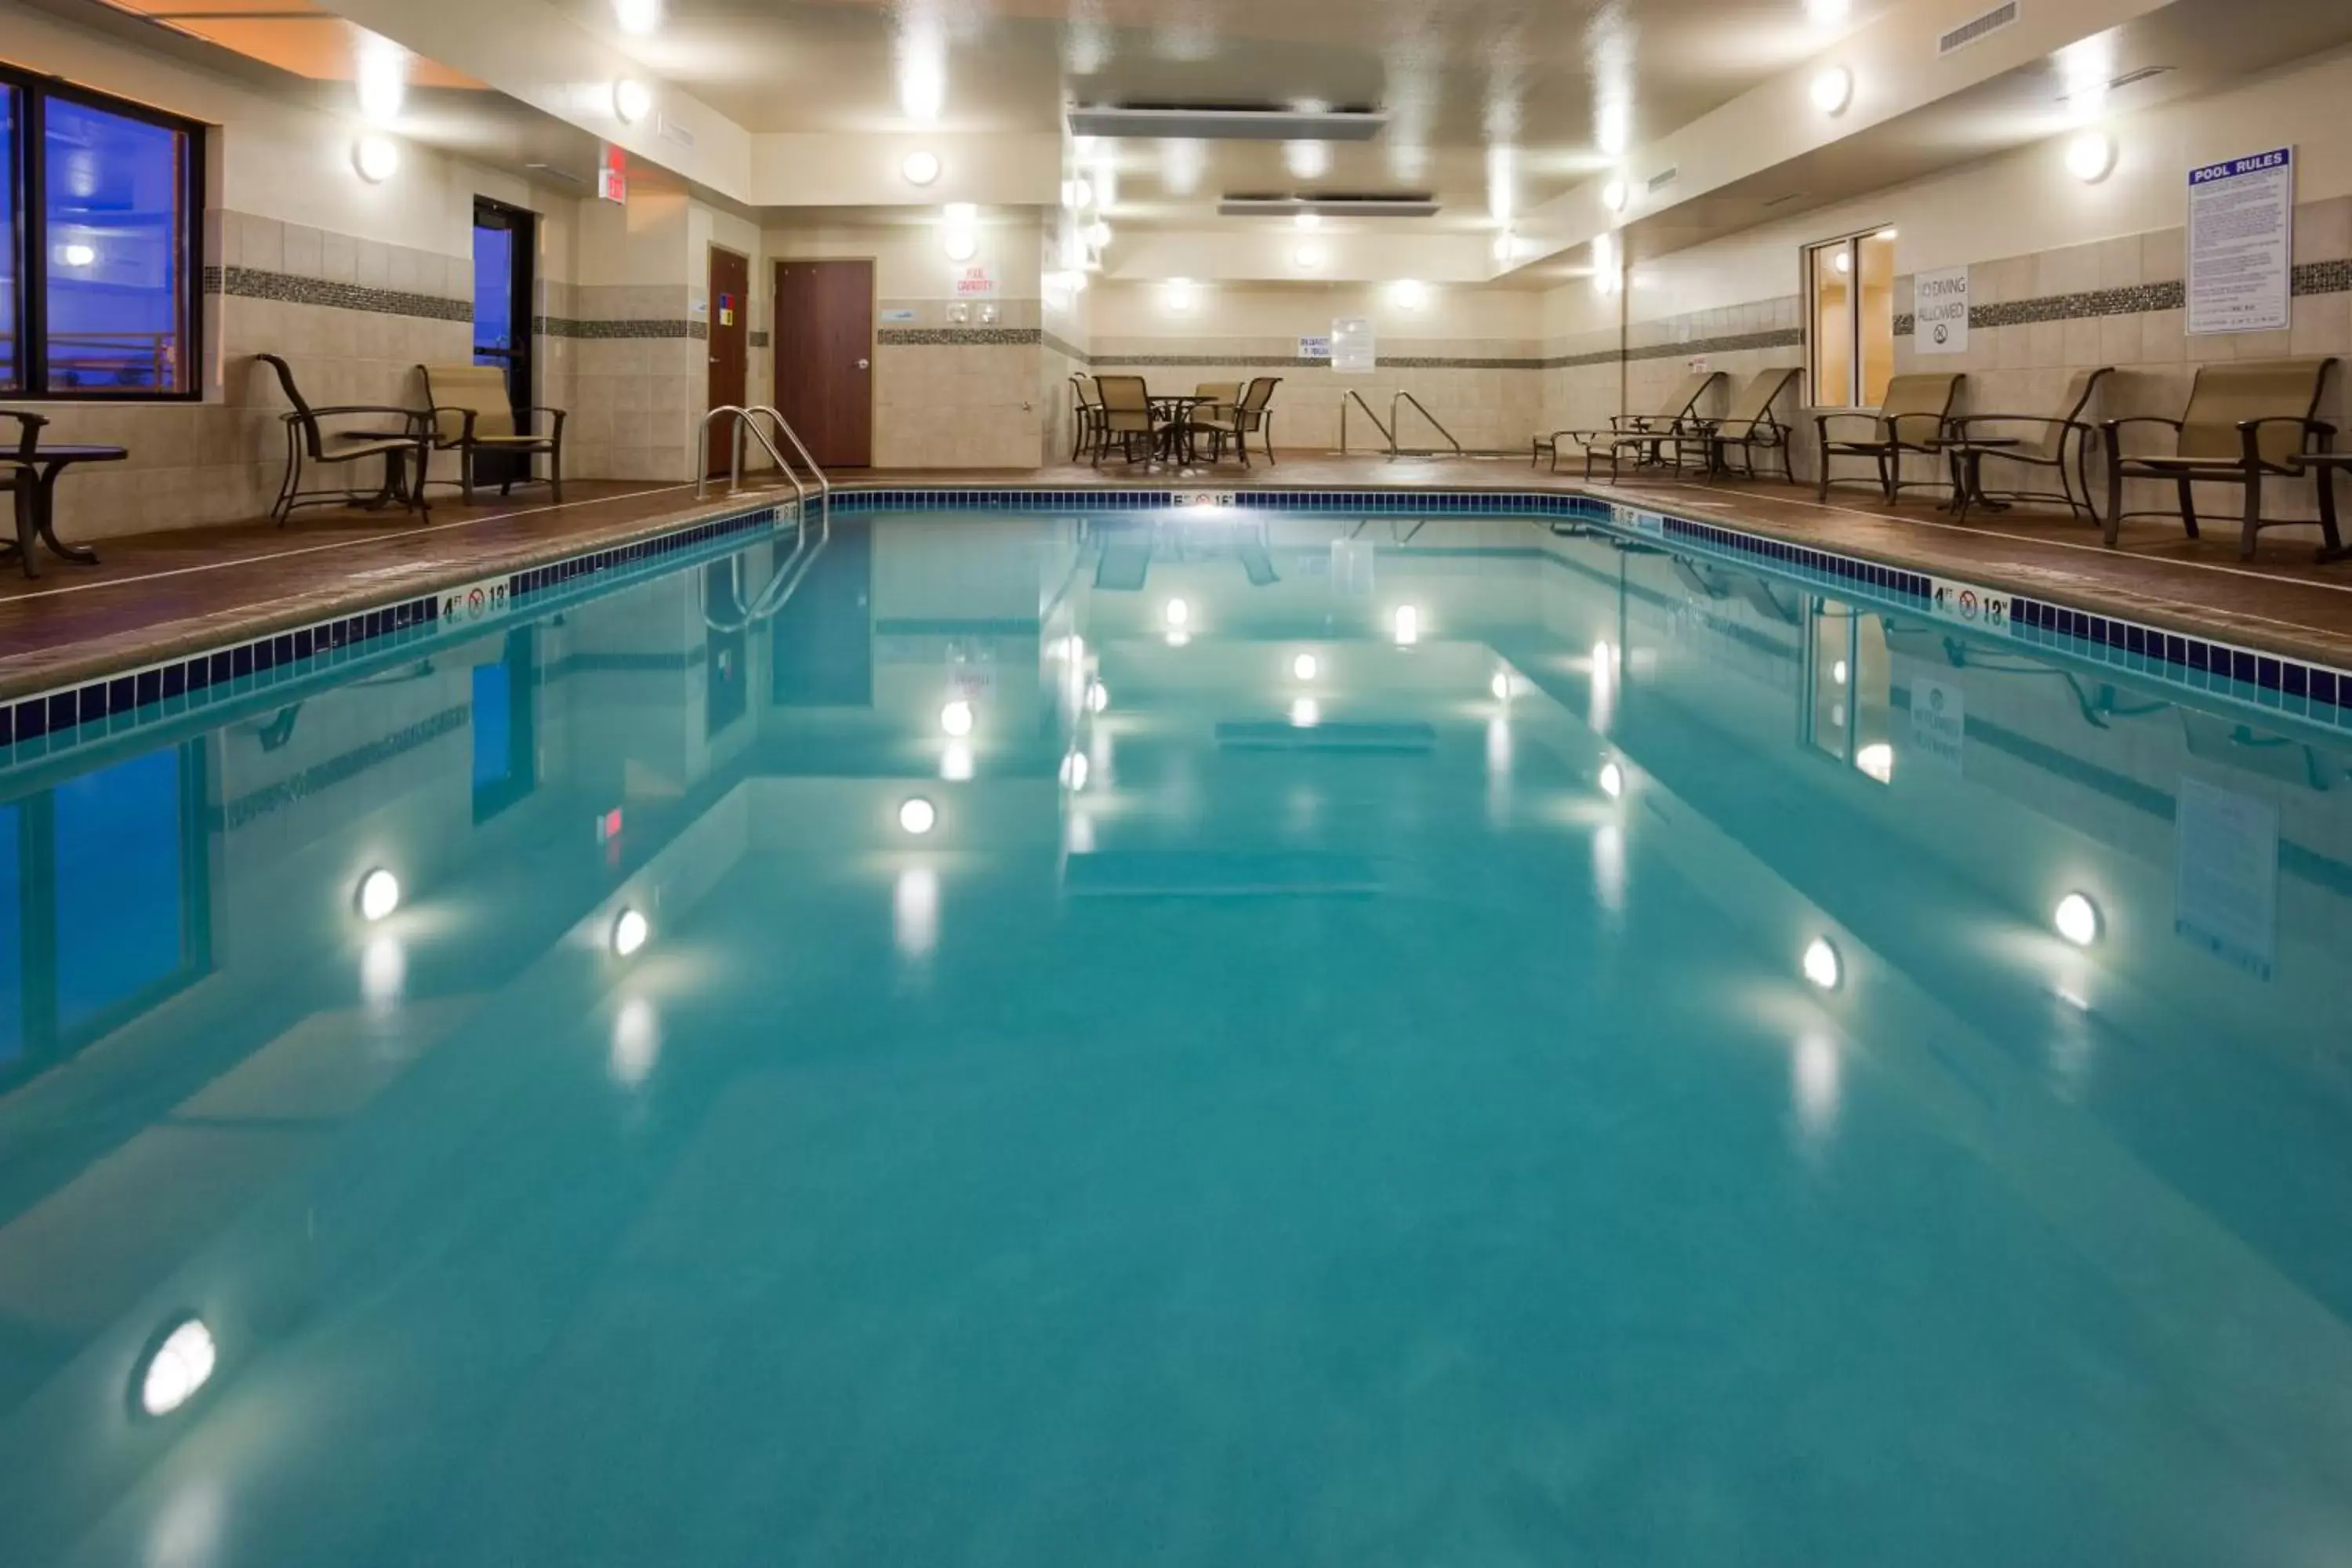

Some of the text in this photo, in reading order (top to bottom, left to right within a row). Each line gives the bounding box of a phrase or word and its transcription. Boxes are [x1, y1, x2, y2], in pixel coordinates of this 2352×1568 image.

[2194, 153, 2282, 182] POOL RULES
[1933, 276, 1965, 296] DIVING
[1918, 302, 1964, 321] ALLOWED
